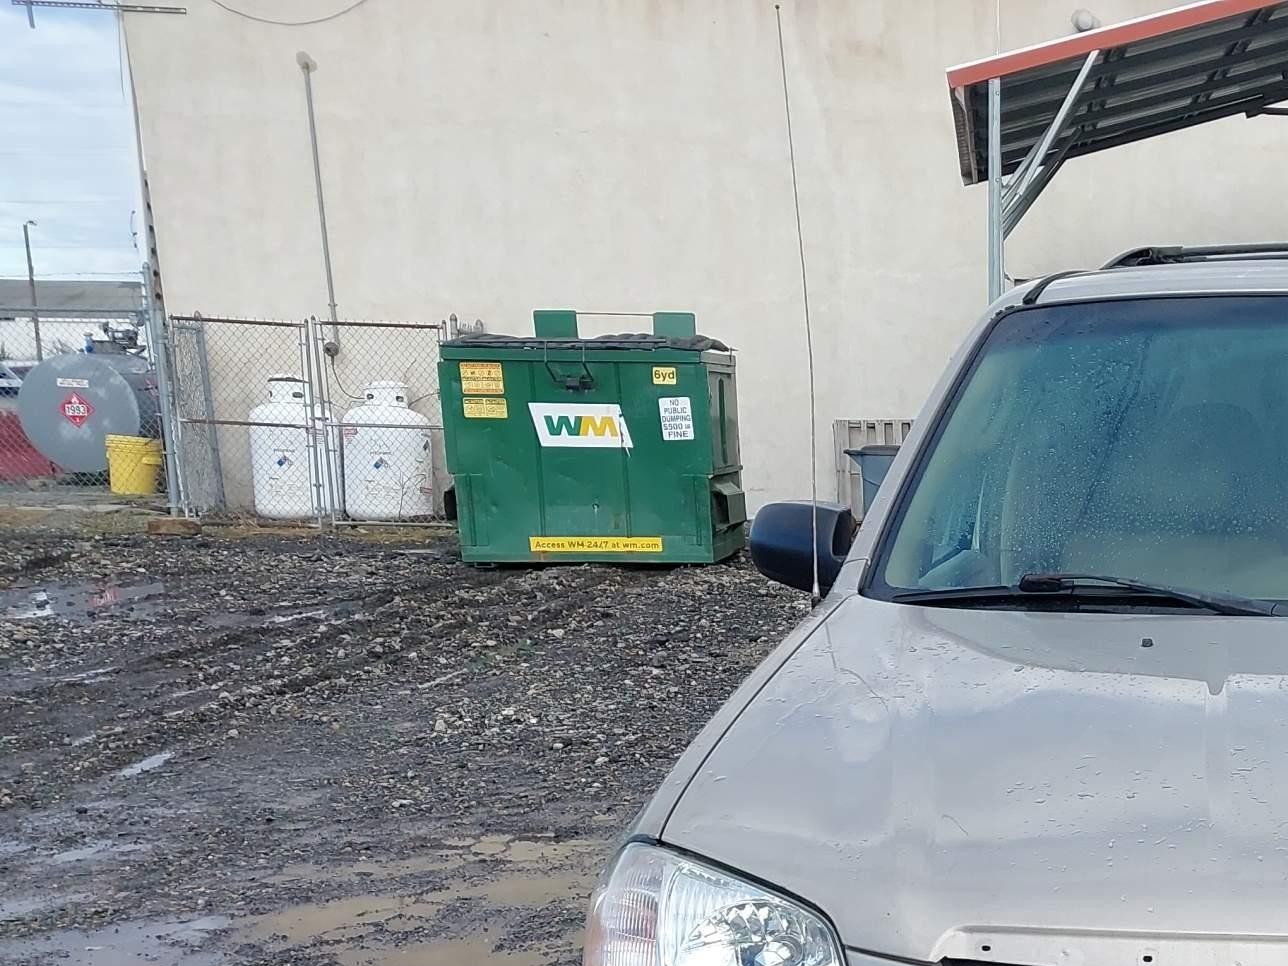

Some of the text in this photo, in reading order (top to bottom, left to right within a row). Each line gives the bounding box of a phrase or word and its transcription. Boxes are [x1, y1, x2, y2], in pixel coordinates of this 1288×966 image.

[654, 370, 675, 382] 6yd
[66, 405, 86, 415] 1993
[661, 415, 691, 423] DUMPING
[543, 415, 618, 437] WM
[668, 430, 689, 438] FINE
[535, 541, 565, 549] Access
[567, 541, 585, 549] WM
[587, 541, 609, 550] 24/7
[611, 541, 620, 549] at
